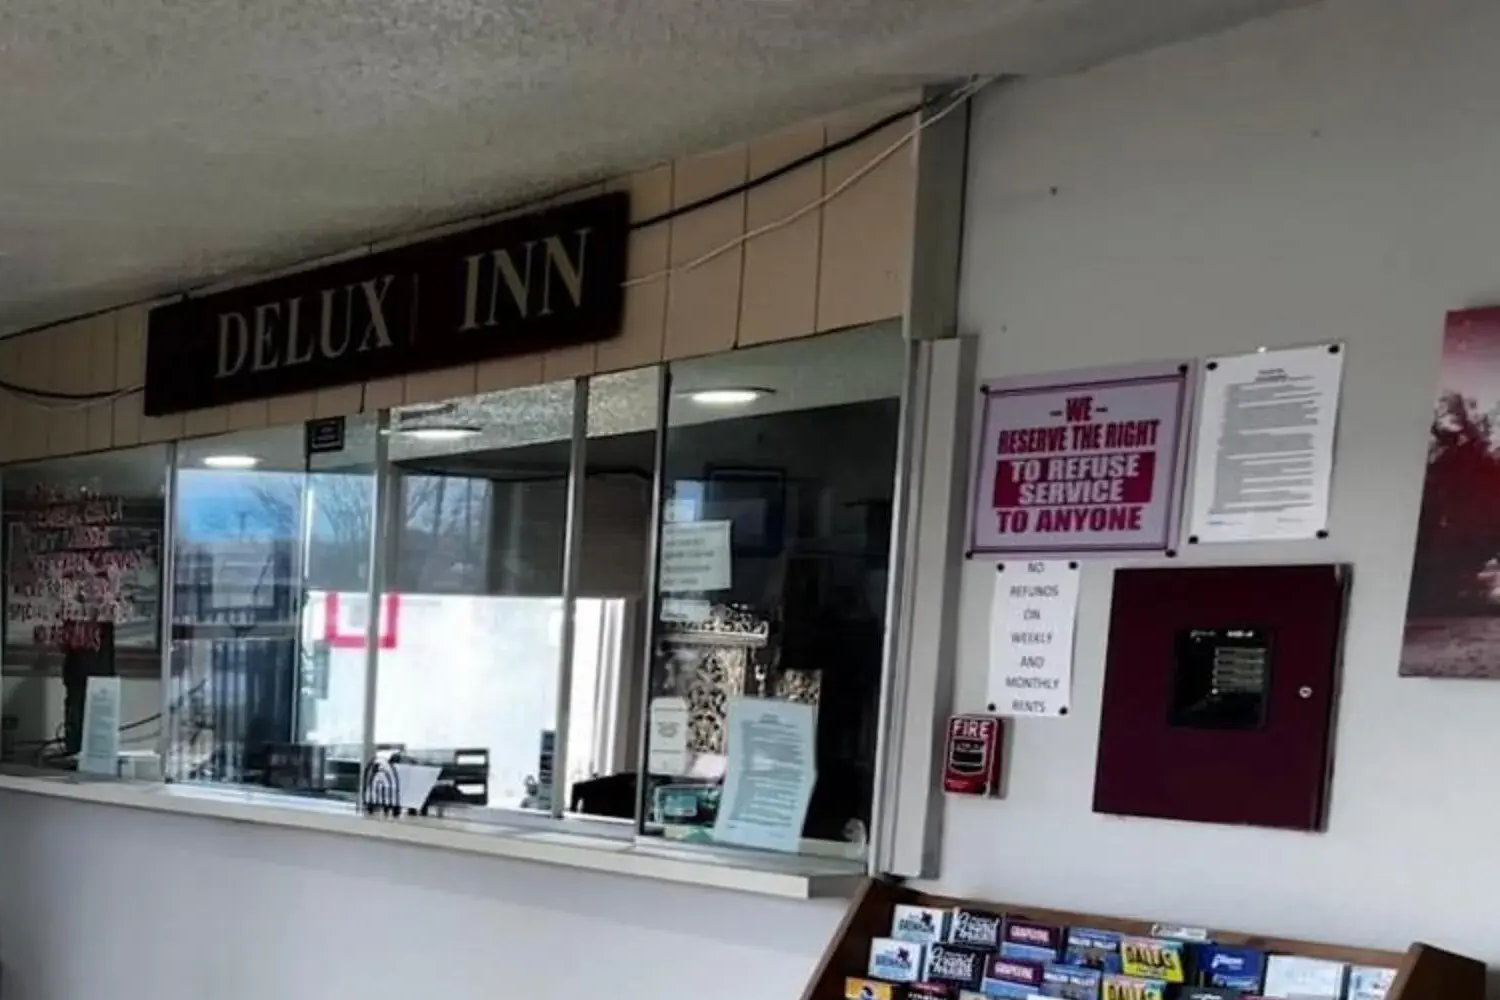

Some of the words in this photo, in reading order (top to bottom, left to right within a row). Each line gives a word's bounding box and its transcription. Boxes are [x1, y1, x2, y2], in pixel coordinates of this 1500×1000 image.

[214, 274, 396, 379] DELUX
[459, 227, 593, 333] INN
[1066, 396, 1093, 422] WE
[998, 427, 1066, 454] RESERVE
[1072, 422, 1101, 450] THE
[1105, 419, 1160, 448] RIGHT
[1011, 459, 1041, 482] TO
[1048, 455, 1140, 481] REFUSE
[1019, 479, 1123, 505] SERVICE
[997, 510, 1029, 534] TO
[1036, 506, 1142, 532] ANYONE
[1027, 562, 1045, 573] NO
[1009, 585, 1060, 598] REFUNDS
[1023, 608, 1041, 620] ON
[1011, 631, 1053, 645] WEEKLY
[1019, 655, 1046, 669] AND
[1005, 676, 1060, 690] MONTHLY
[1011, 699, 1047, 713] RENTS
[953, 718, 991, 738] FIRE
[1124, 944, 1176, 970] DALLAS
